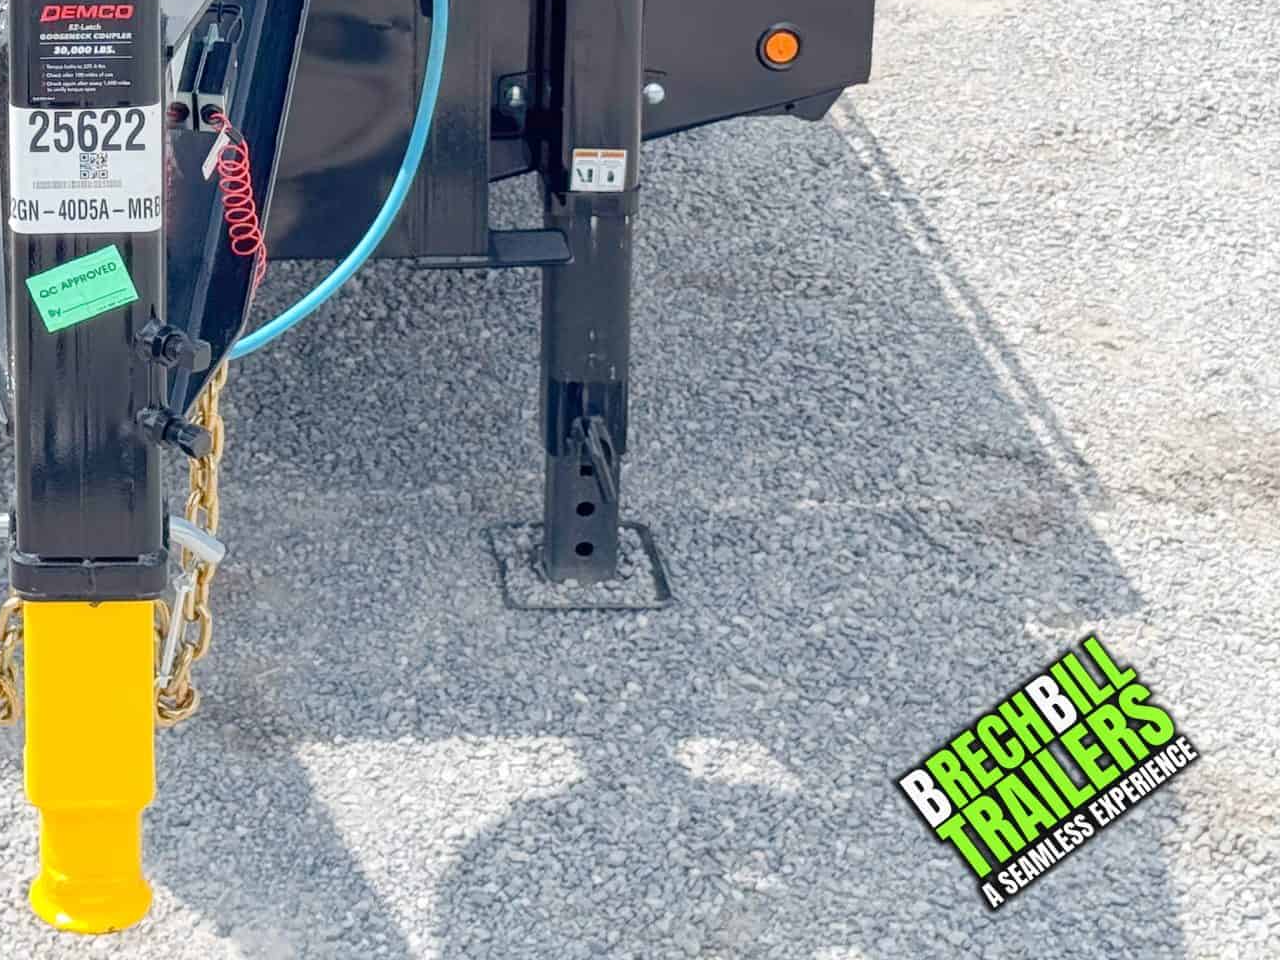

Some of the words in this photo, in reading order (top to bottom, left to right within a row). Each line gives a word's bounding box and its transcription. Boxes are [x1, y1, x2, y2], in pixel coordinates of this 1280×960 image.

[40, 5, 134, 22] DEMCO
[40, 32, 92, 41] GOOSENECK
[93, 31, 132, 40] COUPLER
[53, 45, 92, 55] 30,000
[29, 110, 146, 153] 25622
[39, 286, 58, 298] QC
[61, 262, 117, 291] APPROVED
